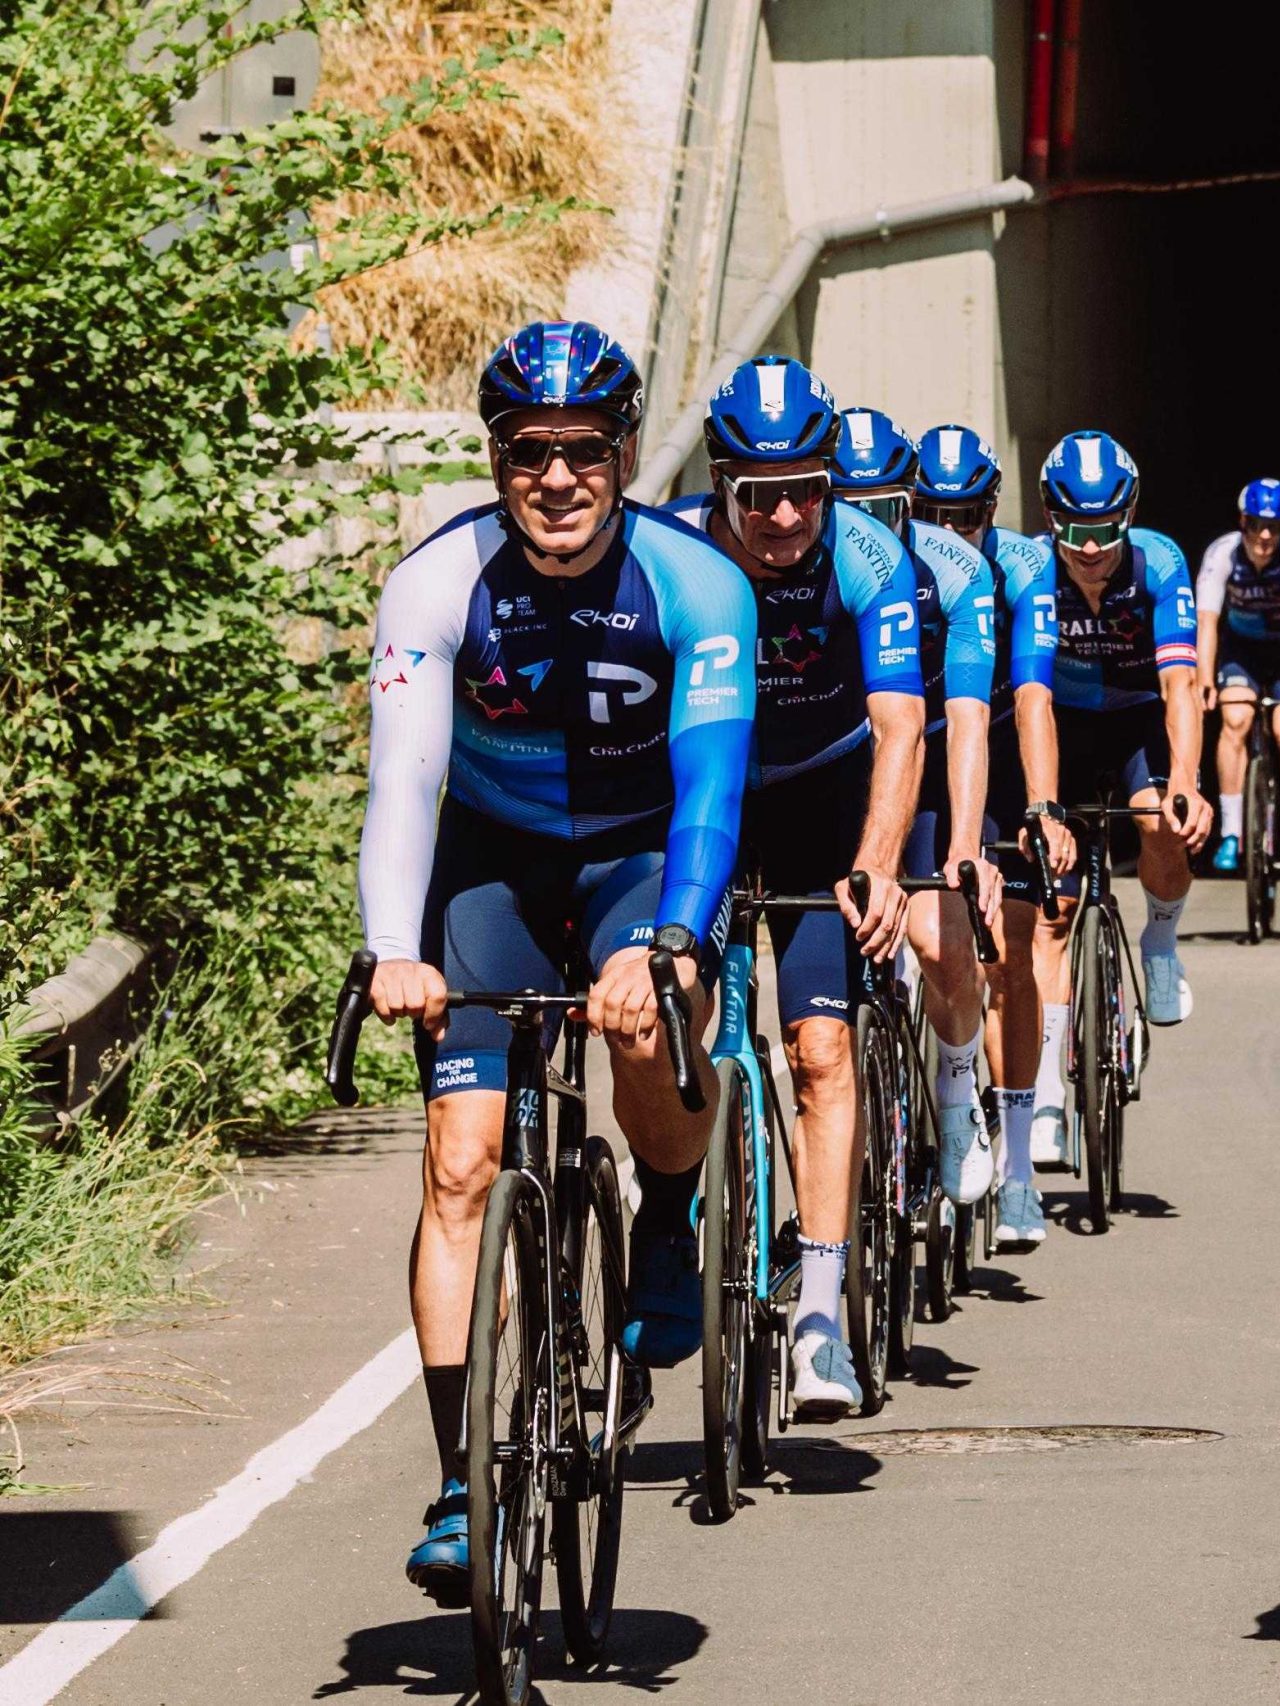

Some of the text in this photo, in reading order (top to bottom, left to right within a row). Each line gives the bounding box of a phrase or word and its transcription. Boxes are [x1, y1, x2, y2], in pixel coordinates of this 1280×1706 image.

[845, 526, 894, 593] FANTINI
[924, 536, 982, 586] FANTINI
[999, 541, 1044, 582] FANTINI
[533, 623, 548, 631] INC
[1058, 619, 1107, 636] RAEL
[878, 647, 917, 658] PREMIER
[879, 656, 906, 666] TECH
[686, 687, 738, 699] PREMIER
[686, 696, 720, 706] TECH
[725, 961, 739, 1034] FACTOR
[435, 1057, 475, 1073] RACING
[436, 1072, 478, 1088] CHANGE
